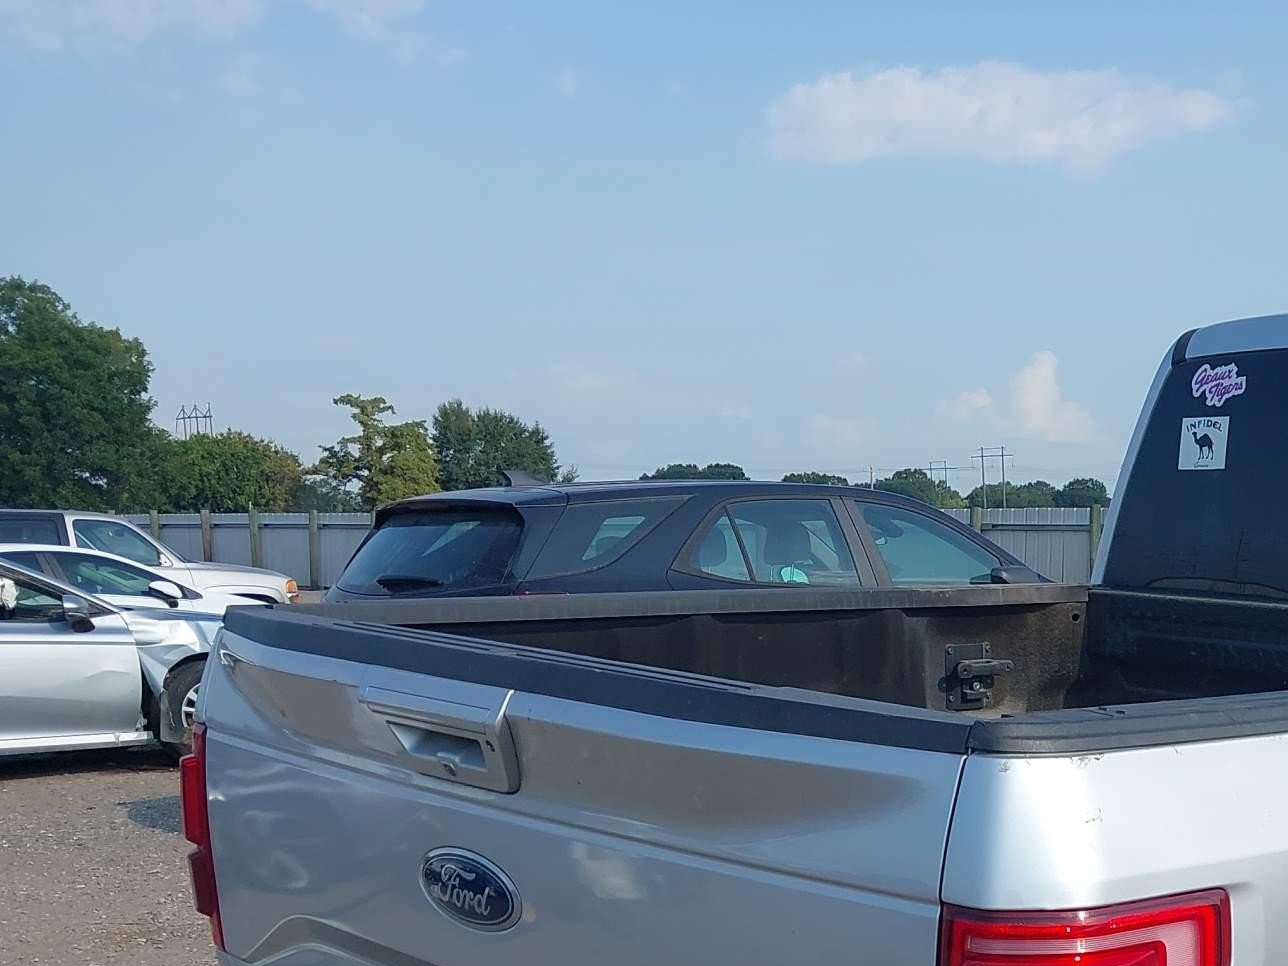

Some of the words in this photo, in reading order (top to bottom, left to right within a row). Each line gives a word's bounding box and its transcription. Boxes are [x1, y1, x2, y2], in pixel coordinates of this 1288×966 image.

[1194, 367, 1234, 393] Geaux
[1208, 381, 1244, 403] Tigers
[1186, 418, 1223, 433] INFIDEL
[438, 863, 491, 916] Ford
